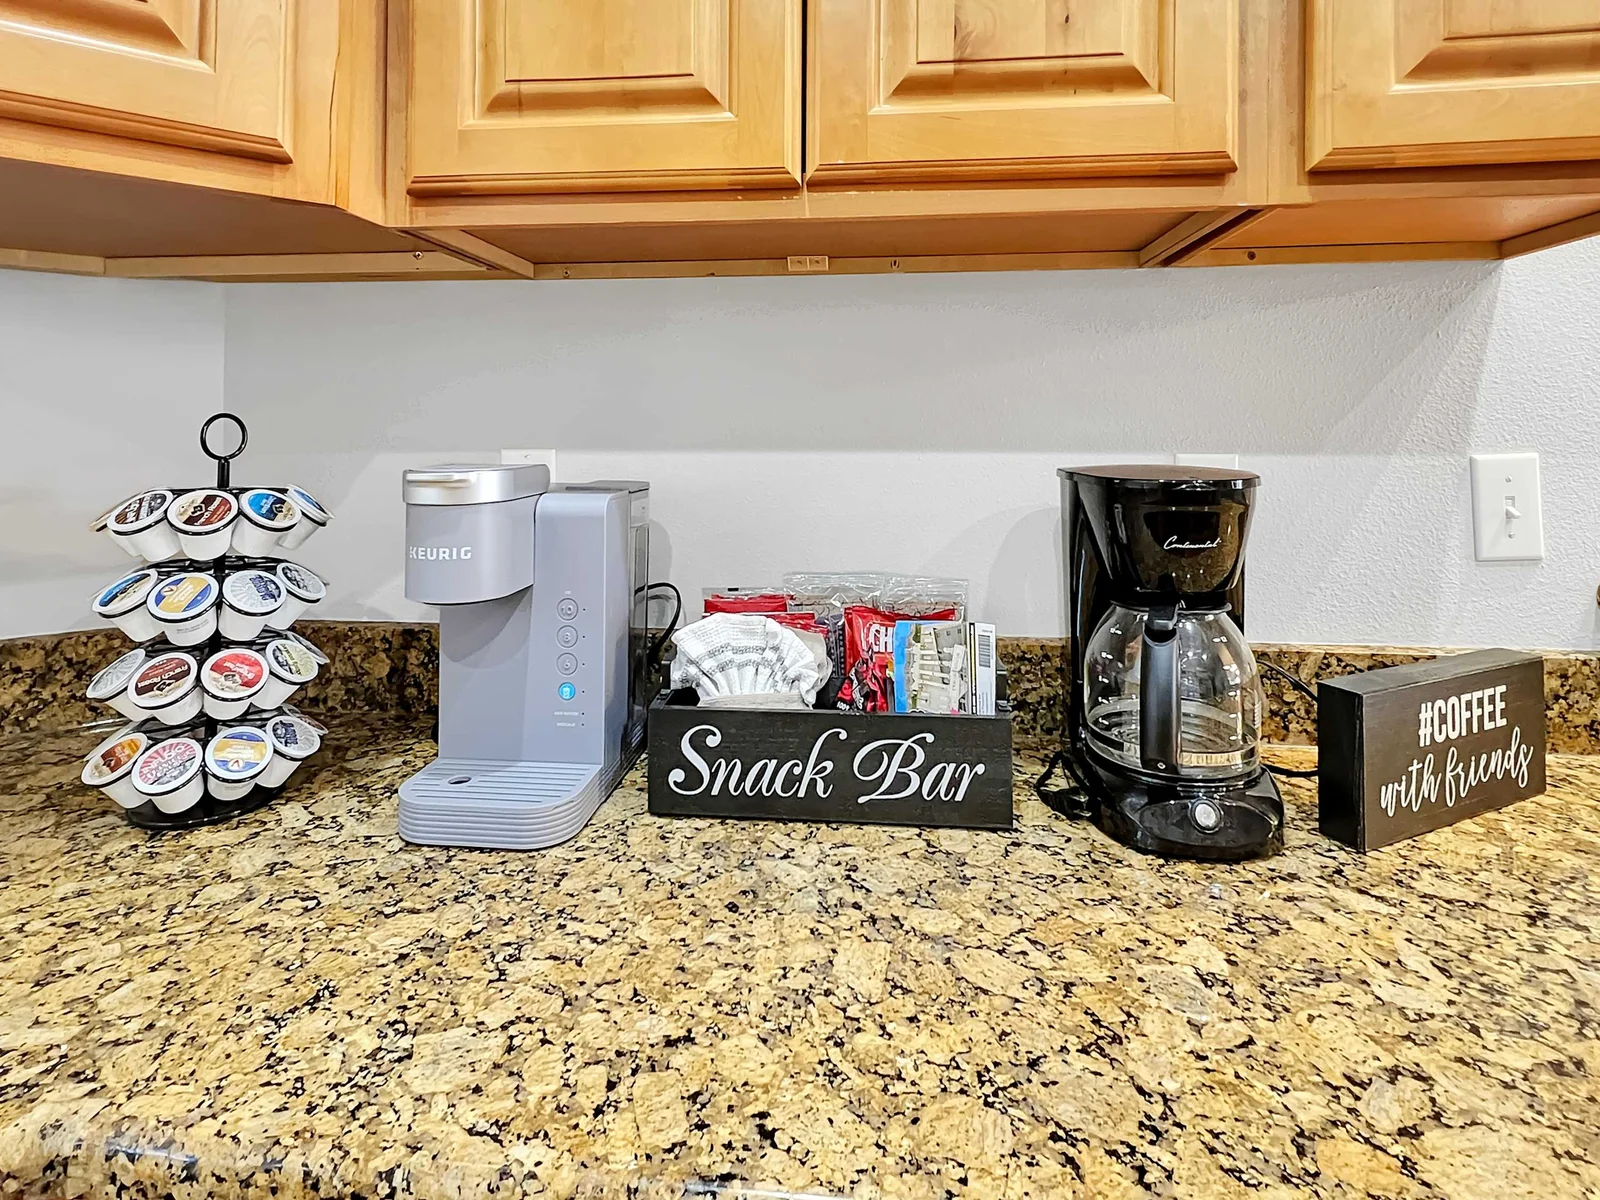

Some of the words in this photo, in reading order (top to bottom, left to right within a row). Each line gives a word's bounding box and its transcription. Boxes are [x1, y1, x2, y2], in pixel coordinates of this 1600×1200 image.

[1163, 535, 1221, 550] Continental
[409, 546, 472, 561] KEURIG
[163, 664, 188, 679] French
[137, 674, 163, 689] Roast
[1418, 684, 1507, 747] #COFFEE
[667, 724, 848, 799] Snack
[853, 732, 986, 804] Bar
[1379, 753, 1442, 818] with
[1444, 726, 1534, 808] friends
